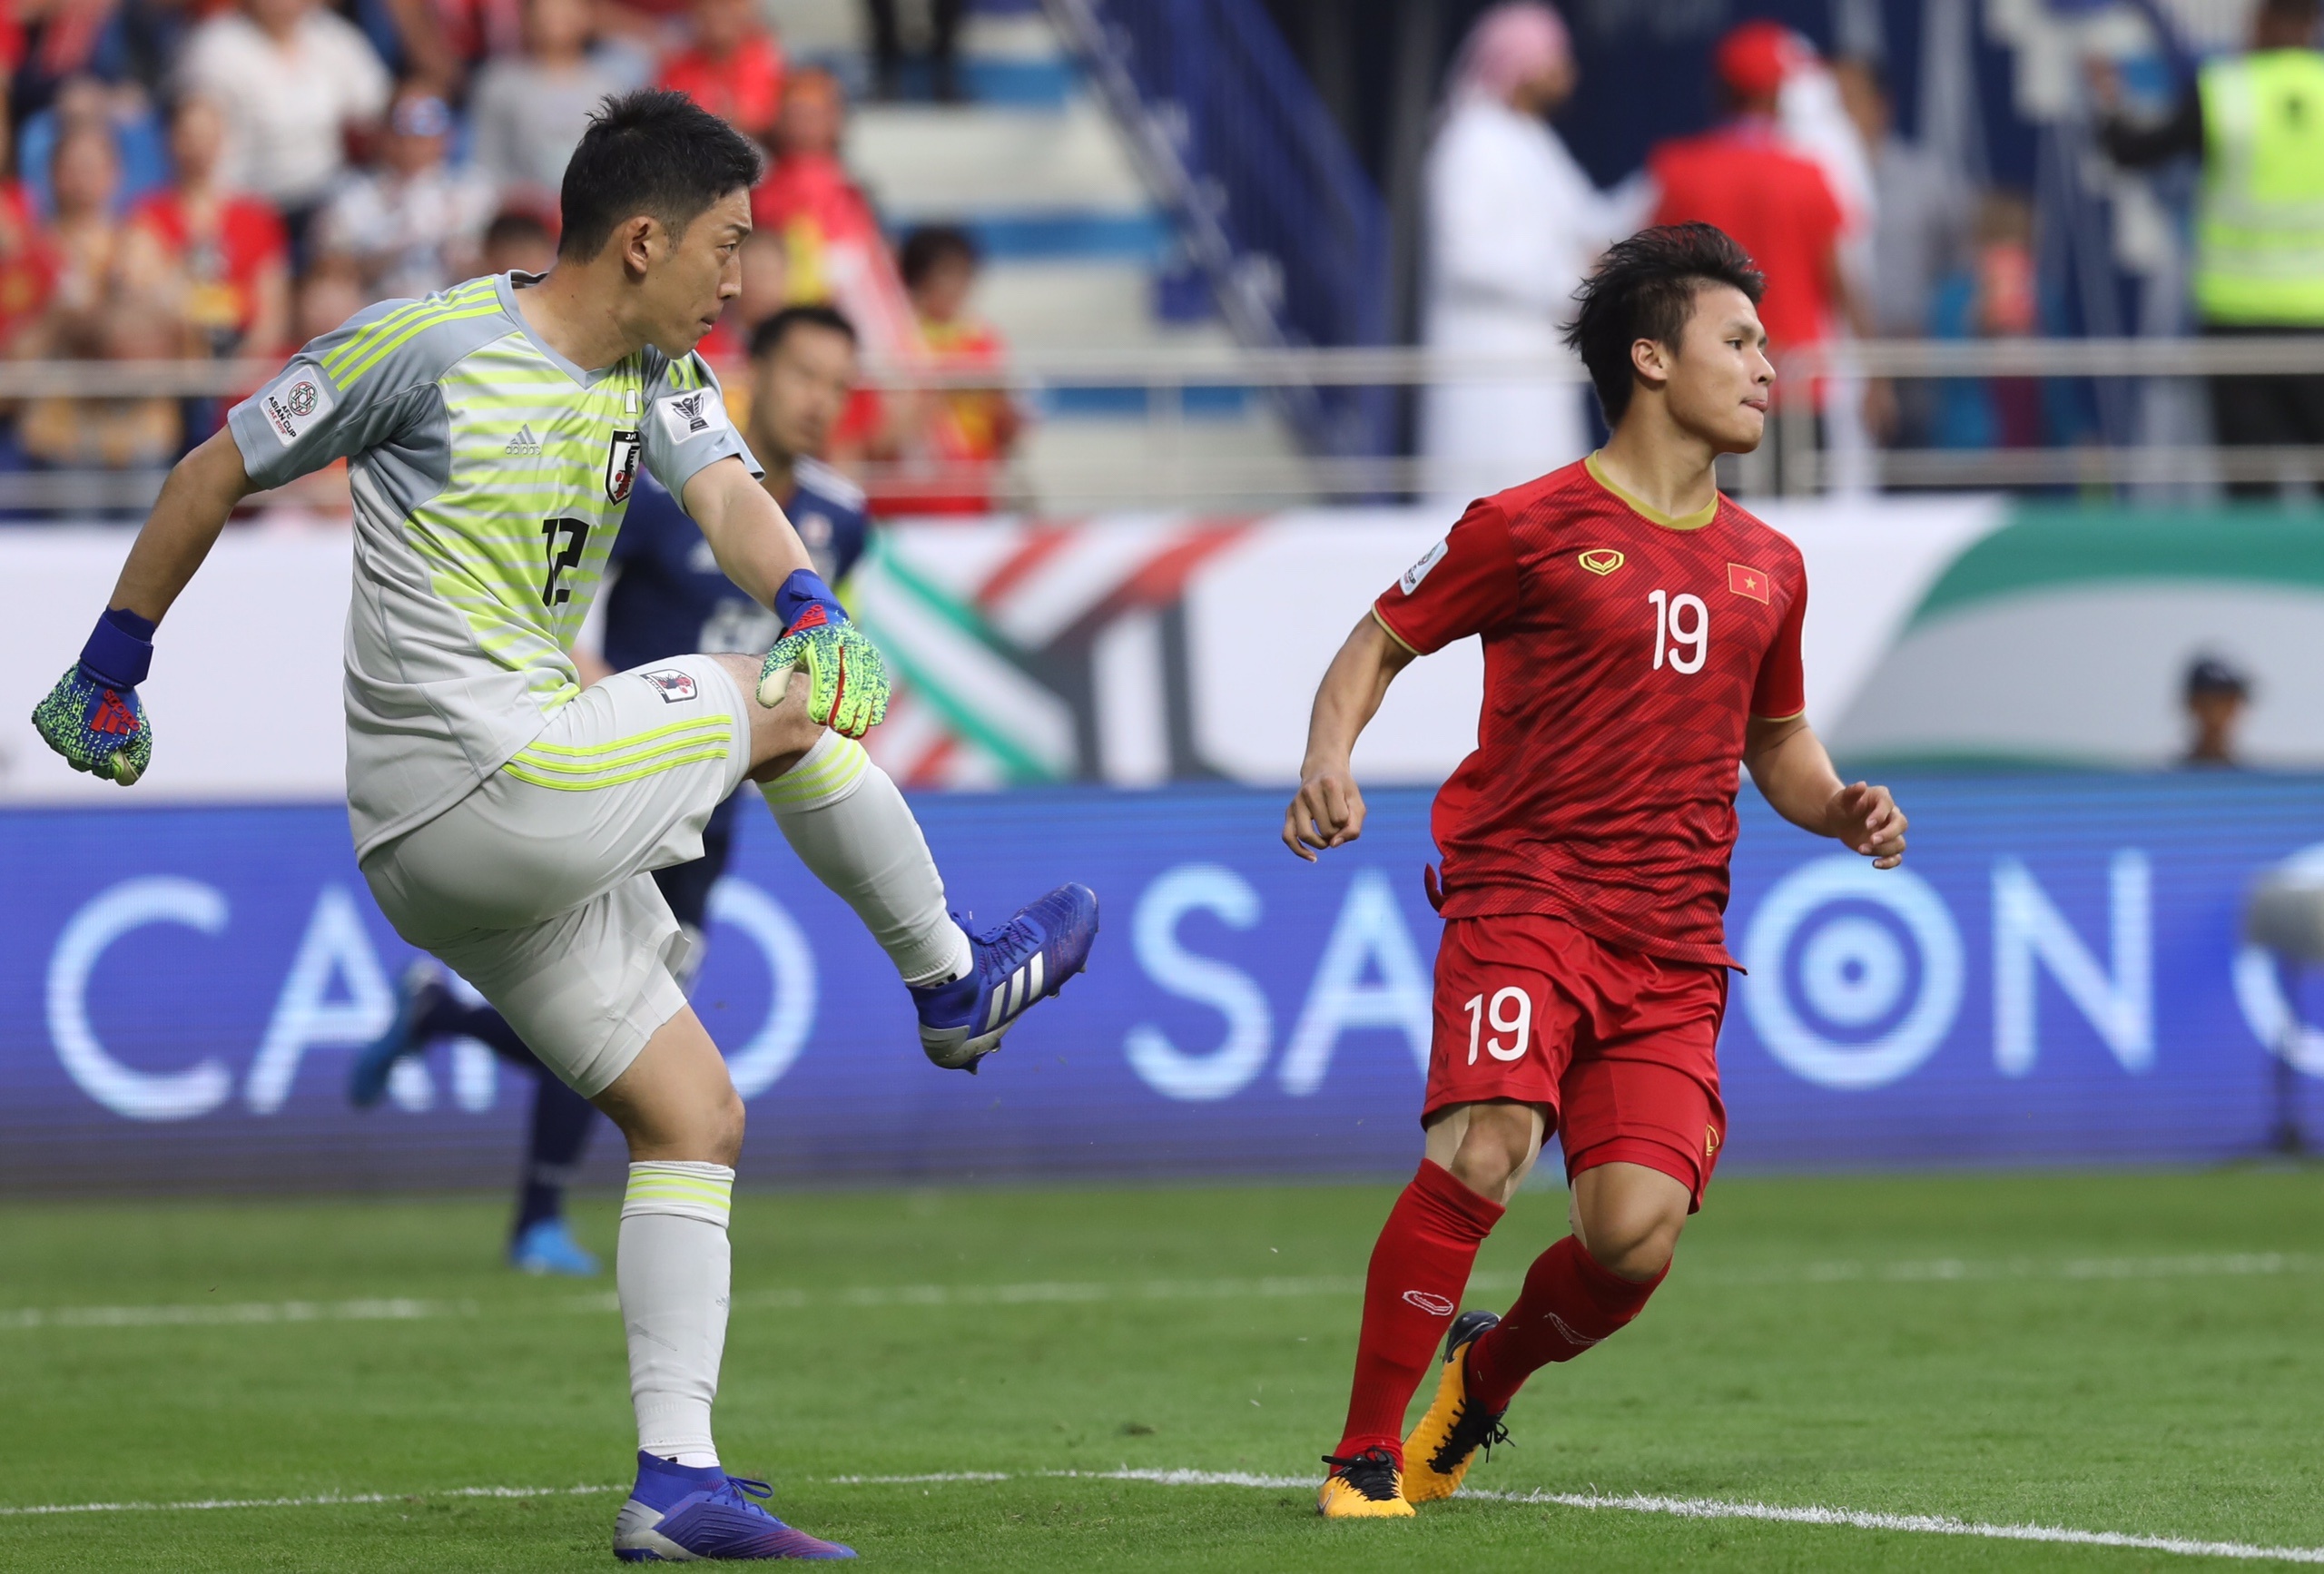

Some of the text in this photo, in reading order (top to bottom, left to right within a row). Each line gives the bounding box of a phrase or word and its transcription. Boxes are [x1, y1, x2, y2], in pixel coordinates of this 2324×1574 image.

[269, 408, 278, 420] UAE
[269, 396, 297, 437] ASIAN CUP
[281, 405, 292, 419] AFC
[505, 443, 541, 456] adidas
[1648, 588, 1709, 674] 19
[103, 689, 141, 732] adidas
[1463, 986, 1532, 1066] 19
